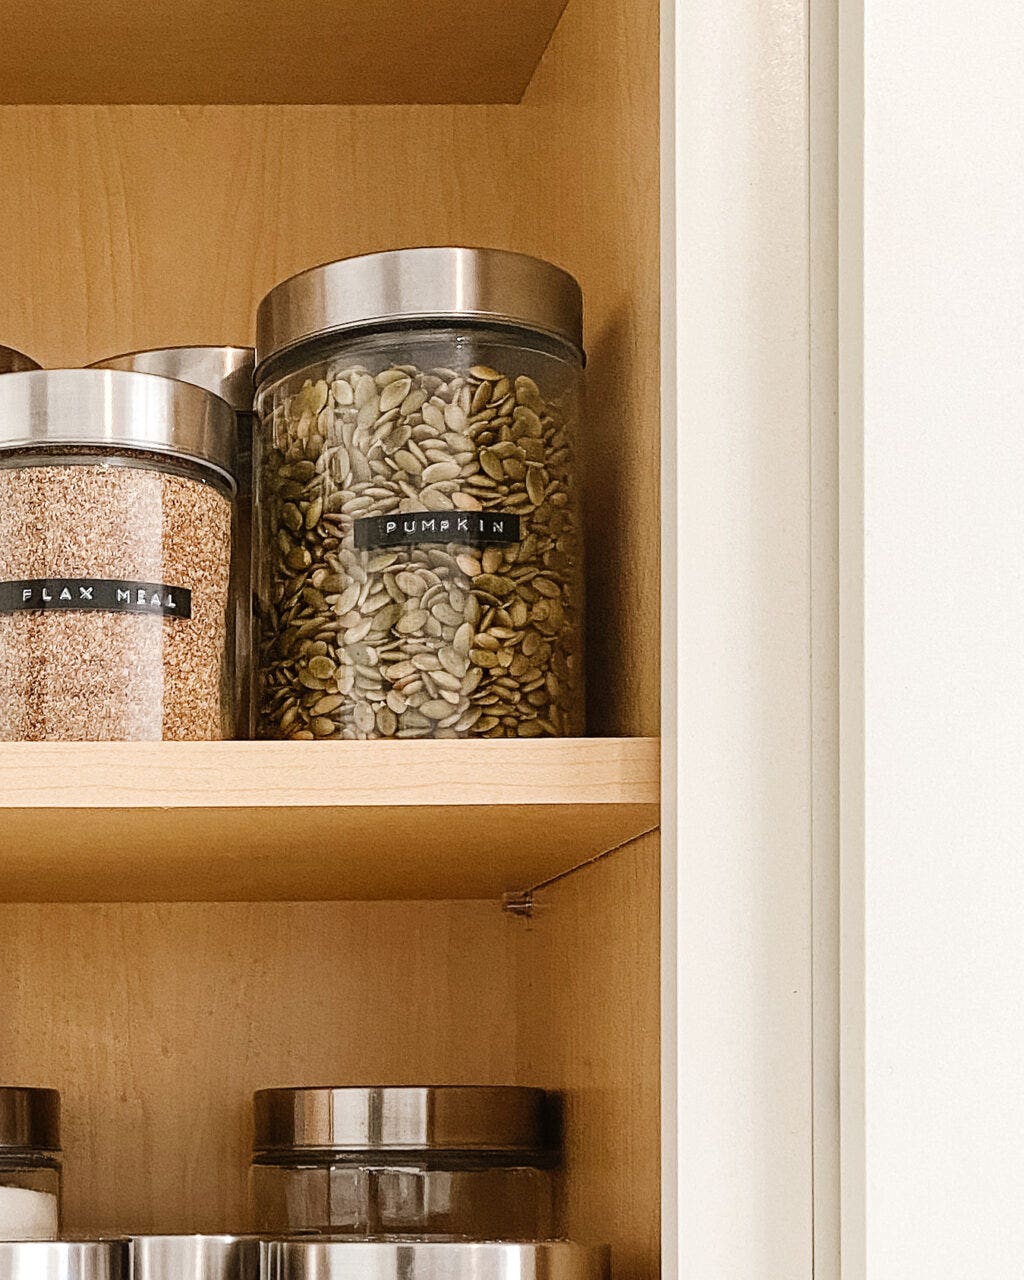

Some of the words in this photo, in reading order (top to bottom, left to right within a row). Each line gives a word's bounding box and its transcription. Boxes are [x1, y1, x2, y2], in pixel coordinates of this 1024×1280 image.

[386, 517, 504, 534] PUMPKIN
[22, 586, 94, 601] FLAX
[116, 588, 177, 609] MEAL
